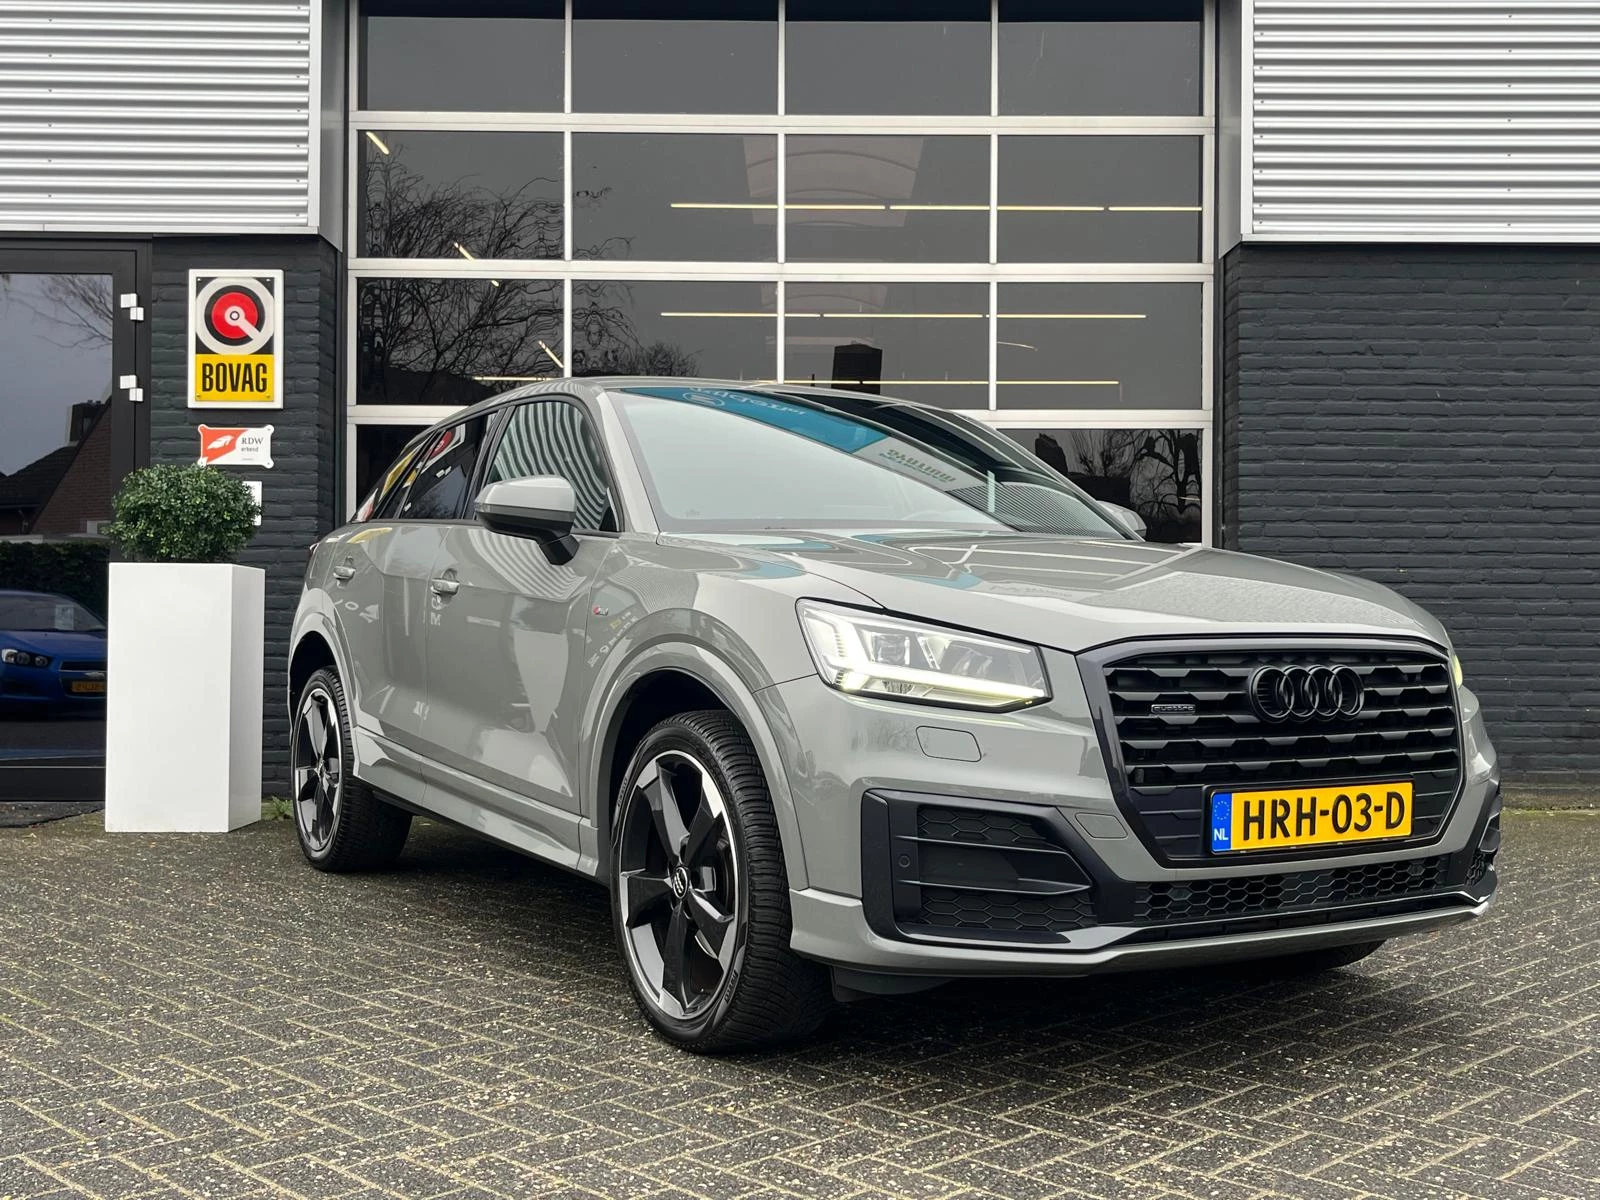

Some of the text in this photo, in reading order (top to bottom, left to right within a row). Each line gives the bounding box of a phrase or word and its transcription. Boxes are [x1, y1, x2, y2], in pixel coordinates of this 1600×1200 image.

[202, 362, 267, 392] BOVAG
[241, 437, 263, 445] RDW
[1242, 791, 1405, 841] HRH-03-D
[1213, 828, 1229, 841] NL
